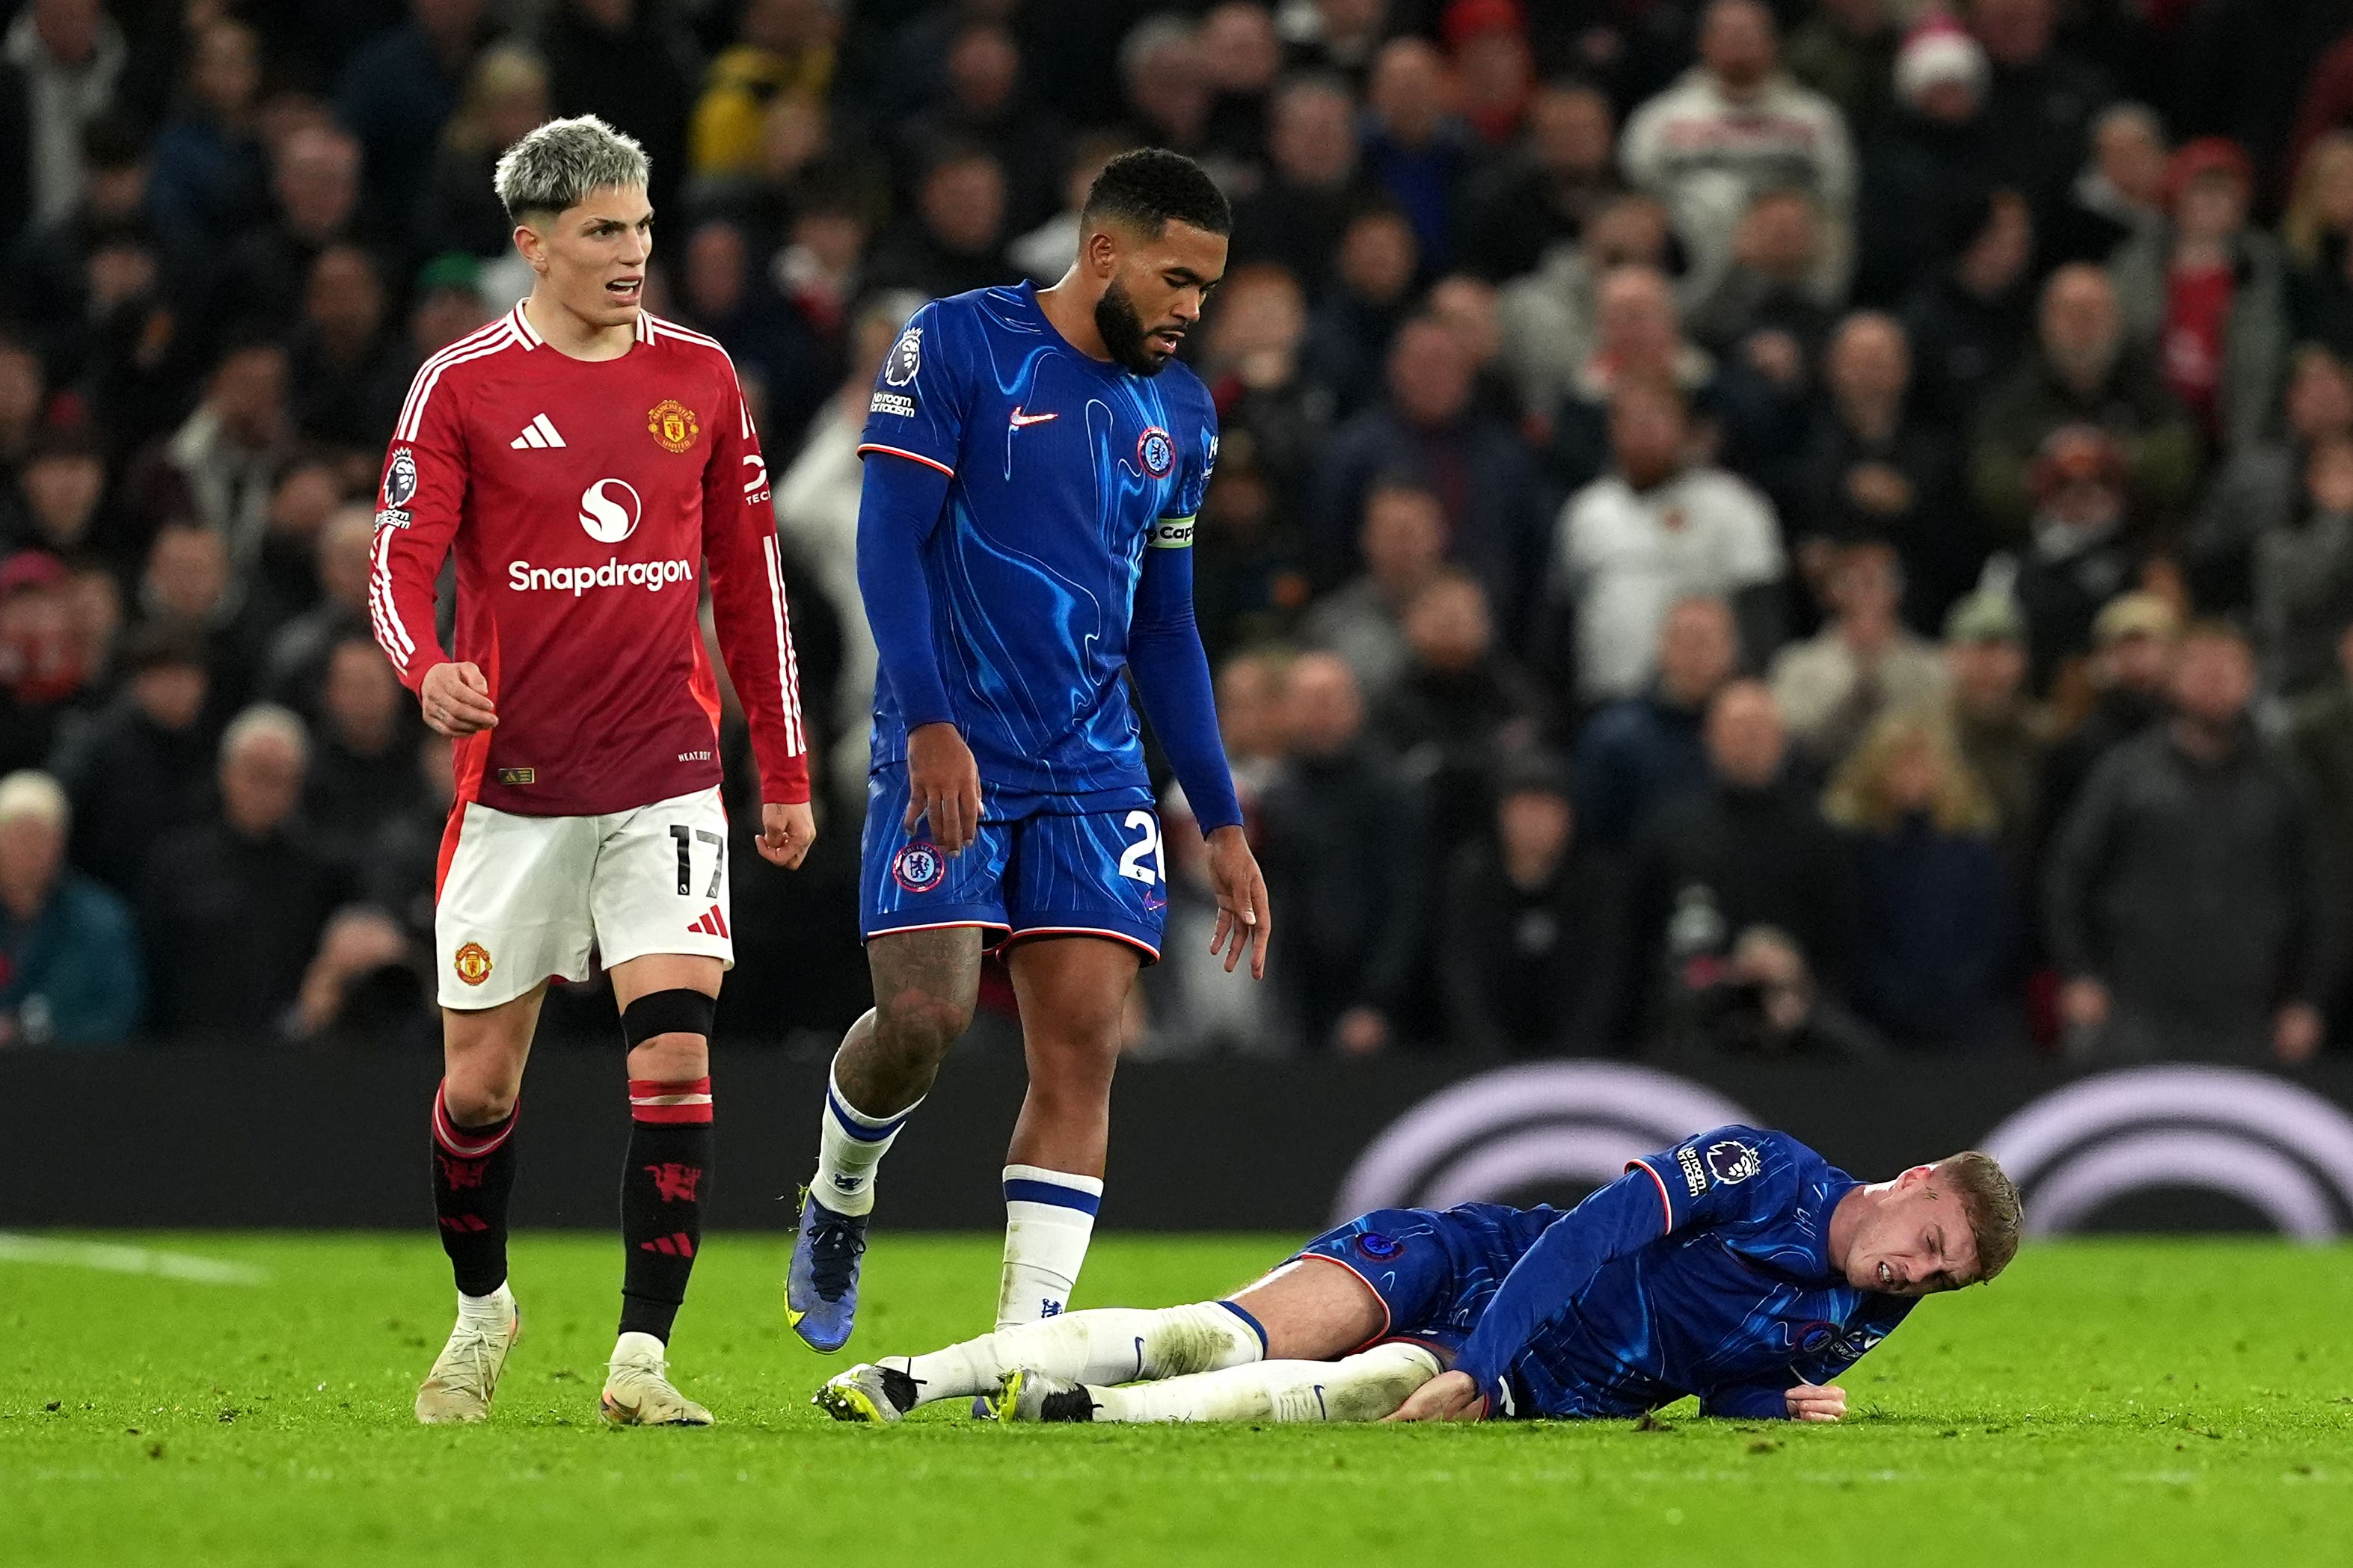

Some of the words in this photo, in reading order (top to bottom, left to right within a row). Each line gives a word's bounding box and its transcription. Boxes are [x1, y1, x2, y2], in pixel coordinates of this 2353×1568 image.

[878, 404, 915, 418] racism
[883, 394, 912, 408] room
[509, 556, 693, 597] Snapdragon
[670, 825, 723, 898] 17
[1680, 1160, 1699, 1197] racism
[1690, 1158, 1707, 1190] room
